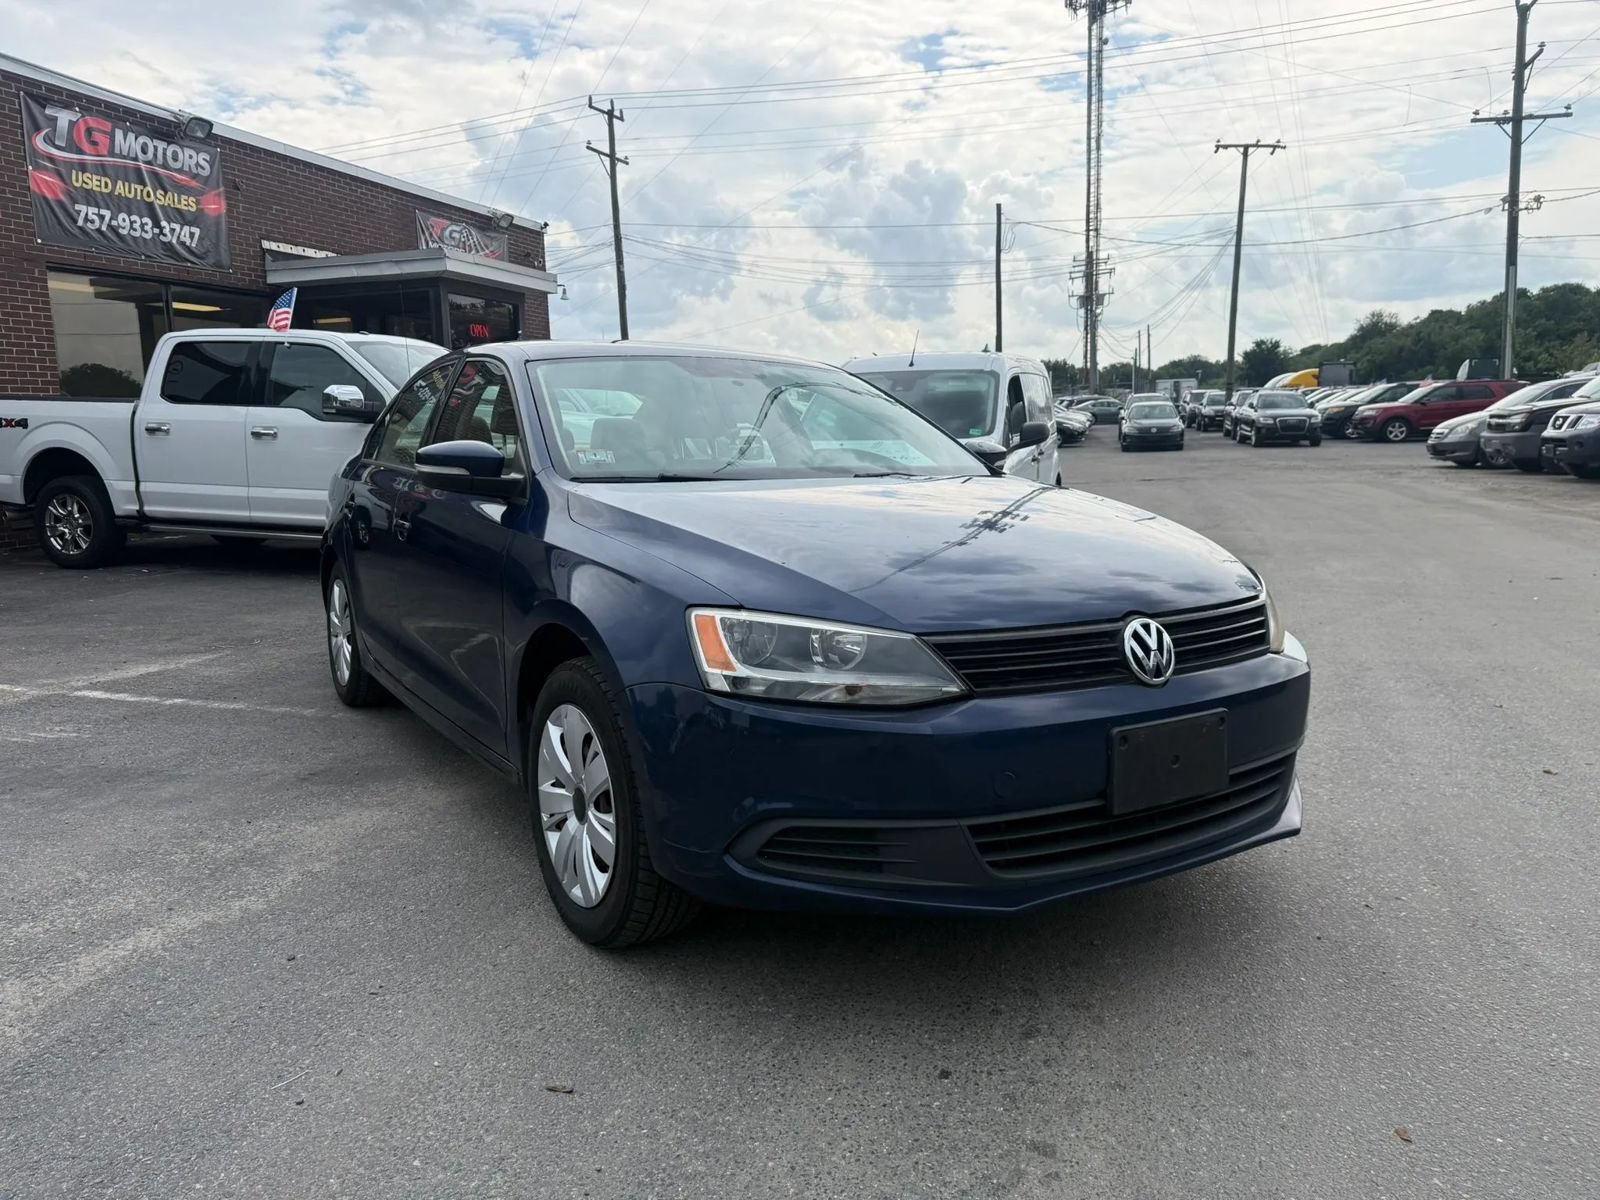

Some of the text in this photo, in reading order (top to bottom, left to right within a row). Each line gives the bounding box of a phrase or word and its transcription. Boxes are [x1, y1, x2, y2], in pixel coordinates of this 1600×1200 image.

[45, 104, 211, 177] TG MOTORS
[71, 169, 197, 212] USED AUTO SALES
[74, 204, 200, 248] 757-933-3747
[470, 324, 489, 337] OPEN
[0, 417, 28, 429] X4
